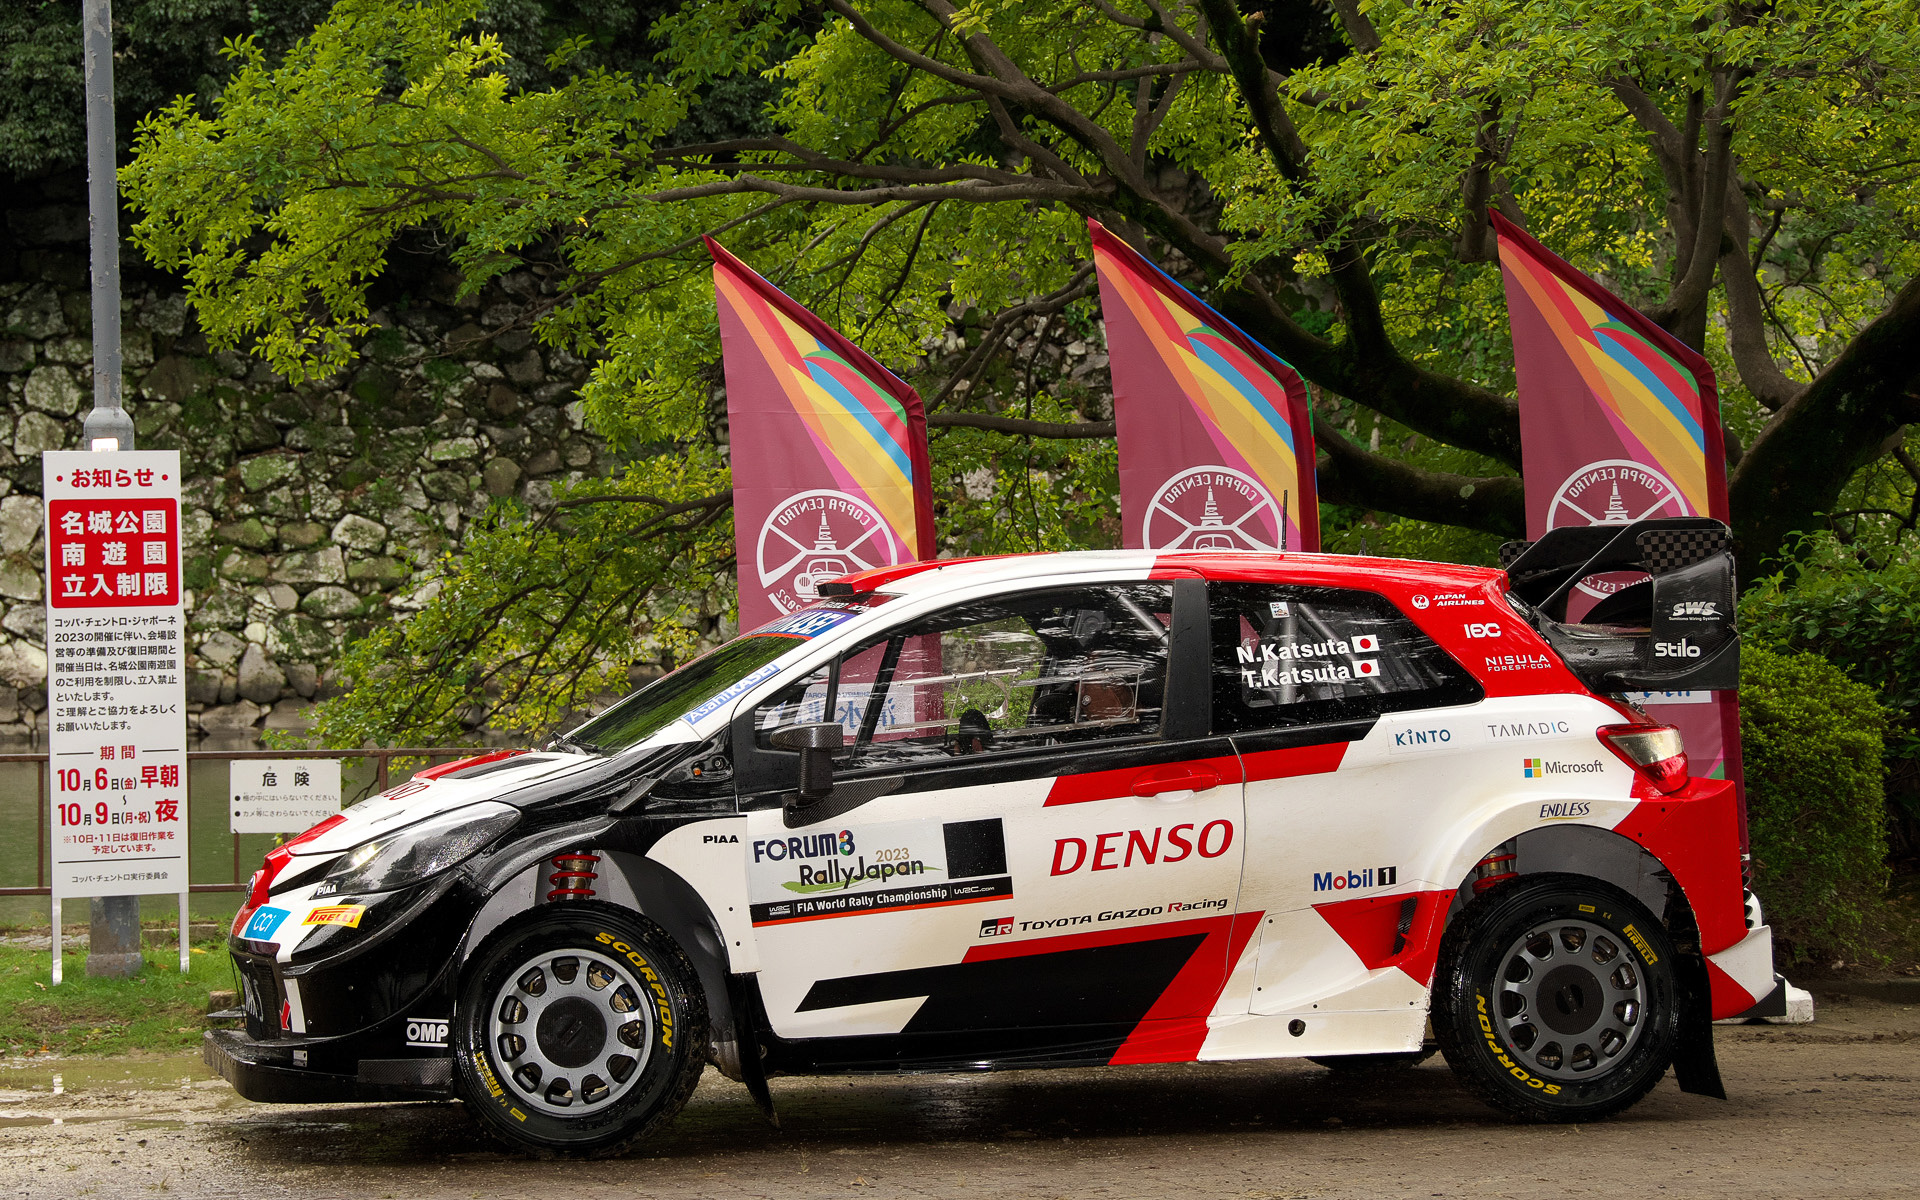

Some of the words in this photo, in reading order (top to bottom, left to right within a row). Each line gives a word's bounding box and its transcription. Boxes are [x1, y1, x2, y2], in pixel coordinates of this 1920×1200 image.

[60, 510, 167, 535] 名城公園
[61, 572, 169, 597] 立入制限
[1436, 599, 1485, 607] AIRLINES
[1672, 601, 1720, 617] SWS
[1236, 639, 1350, 664] N.Katsuta
[1654, 638, 1701, 657] Stilo
[1485, 654, 1549, 666] NISULA
[1242, 664, 1351, 688] T.Katsuta
[55, 692, 115, 702] といたします。
[56, 721, 132, 732] お願いいたします。
[1487, 721, 1569, 738] TAMADIC
[100, 745, 136, 760] 期間
[1545, 759, 1604, 774] Microsoft
[140, 764, 180, 789] 早朝
[262, 771, 310, 787] 危険
[155, 799, 180, 823] 夜
[1539, 802, 1591, 818] ENDLESS
[703, 835, 739, 844] PIAA
[1050, 819, 1234, 877] DENSO
[875, 847, 910, 862] 2023
[1313, 868, 1373, 892] Mobil
[316, 884, 337, 896] PIAA
[797, 902, 815, 913] FIA
[815, 899, 846, 912] World
[849, 895, 874, 908] Rally
[877, 887, 948, 904] Championship
[307, 907, 360, 923] PIRELLI
[980, 922, 1013, 937] GR
[1019, 915, 1092, 931] TOYOTA
[1097, 905, 1163, 922] GAZOO
[1167, 898, 1228, 913] Racing
[1622, 923, 1659, 966] PIRELLI
[595, 931, 673, 1048] SCORPION
[406, 1022, 449, 1043] OMP
[1475, 993, 1562, 1095] SCORPION
